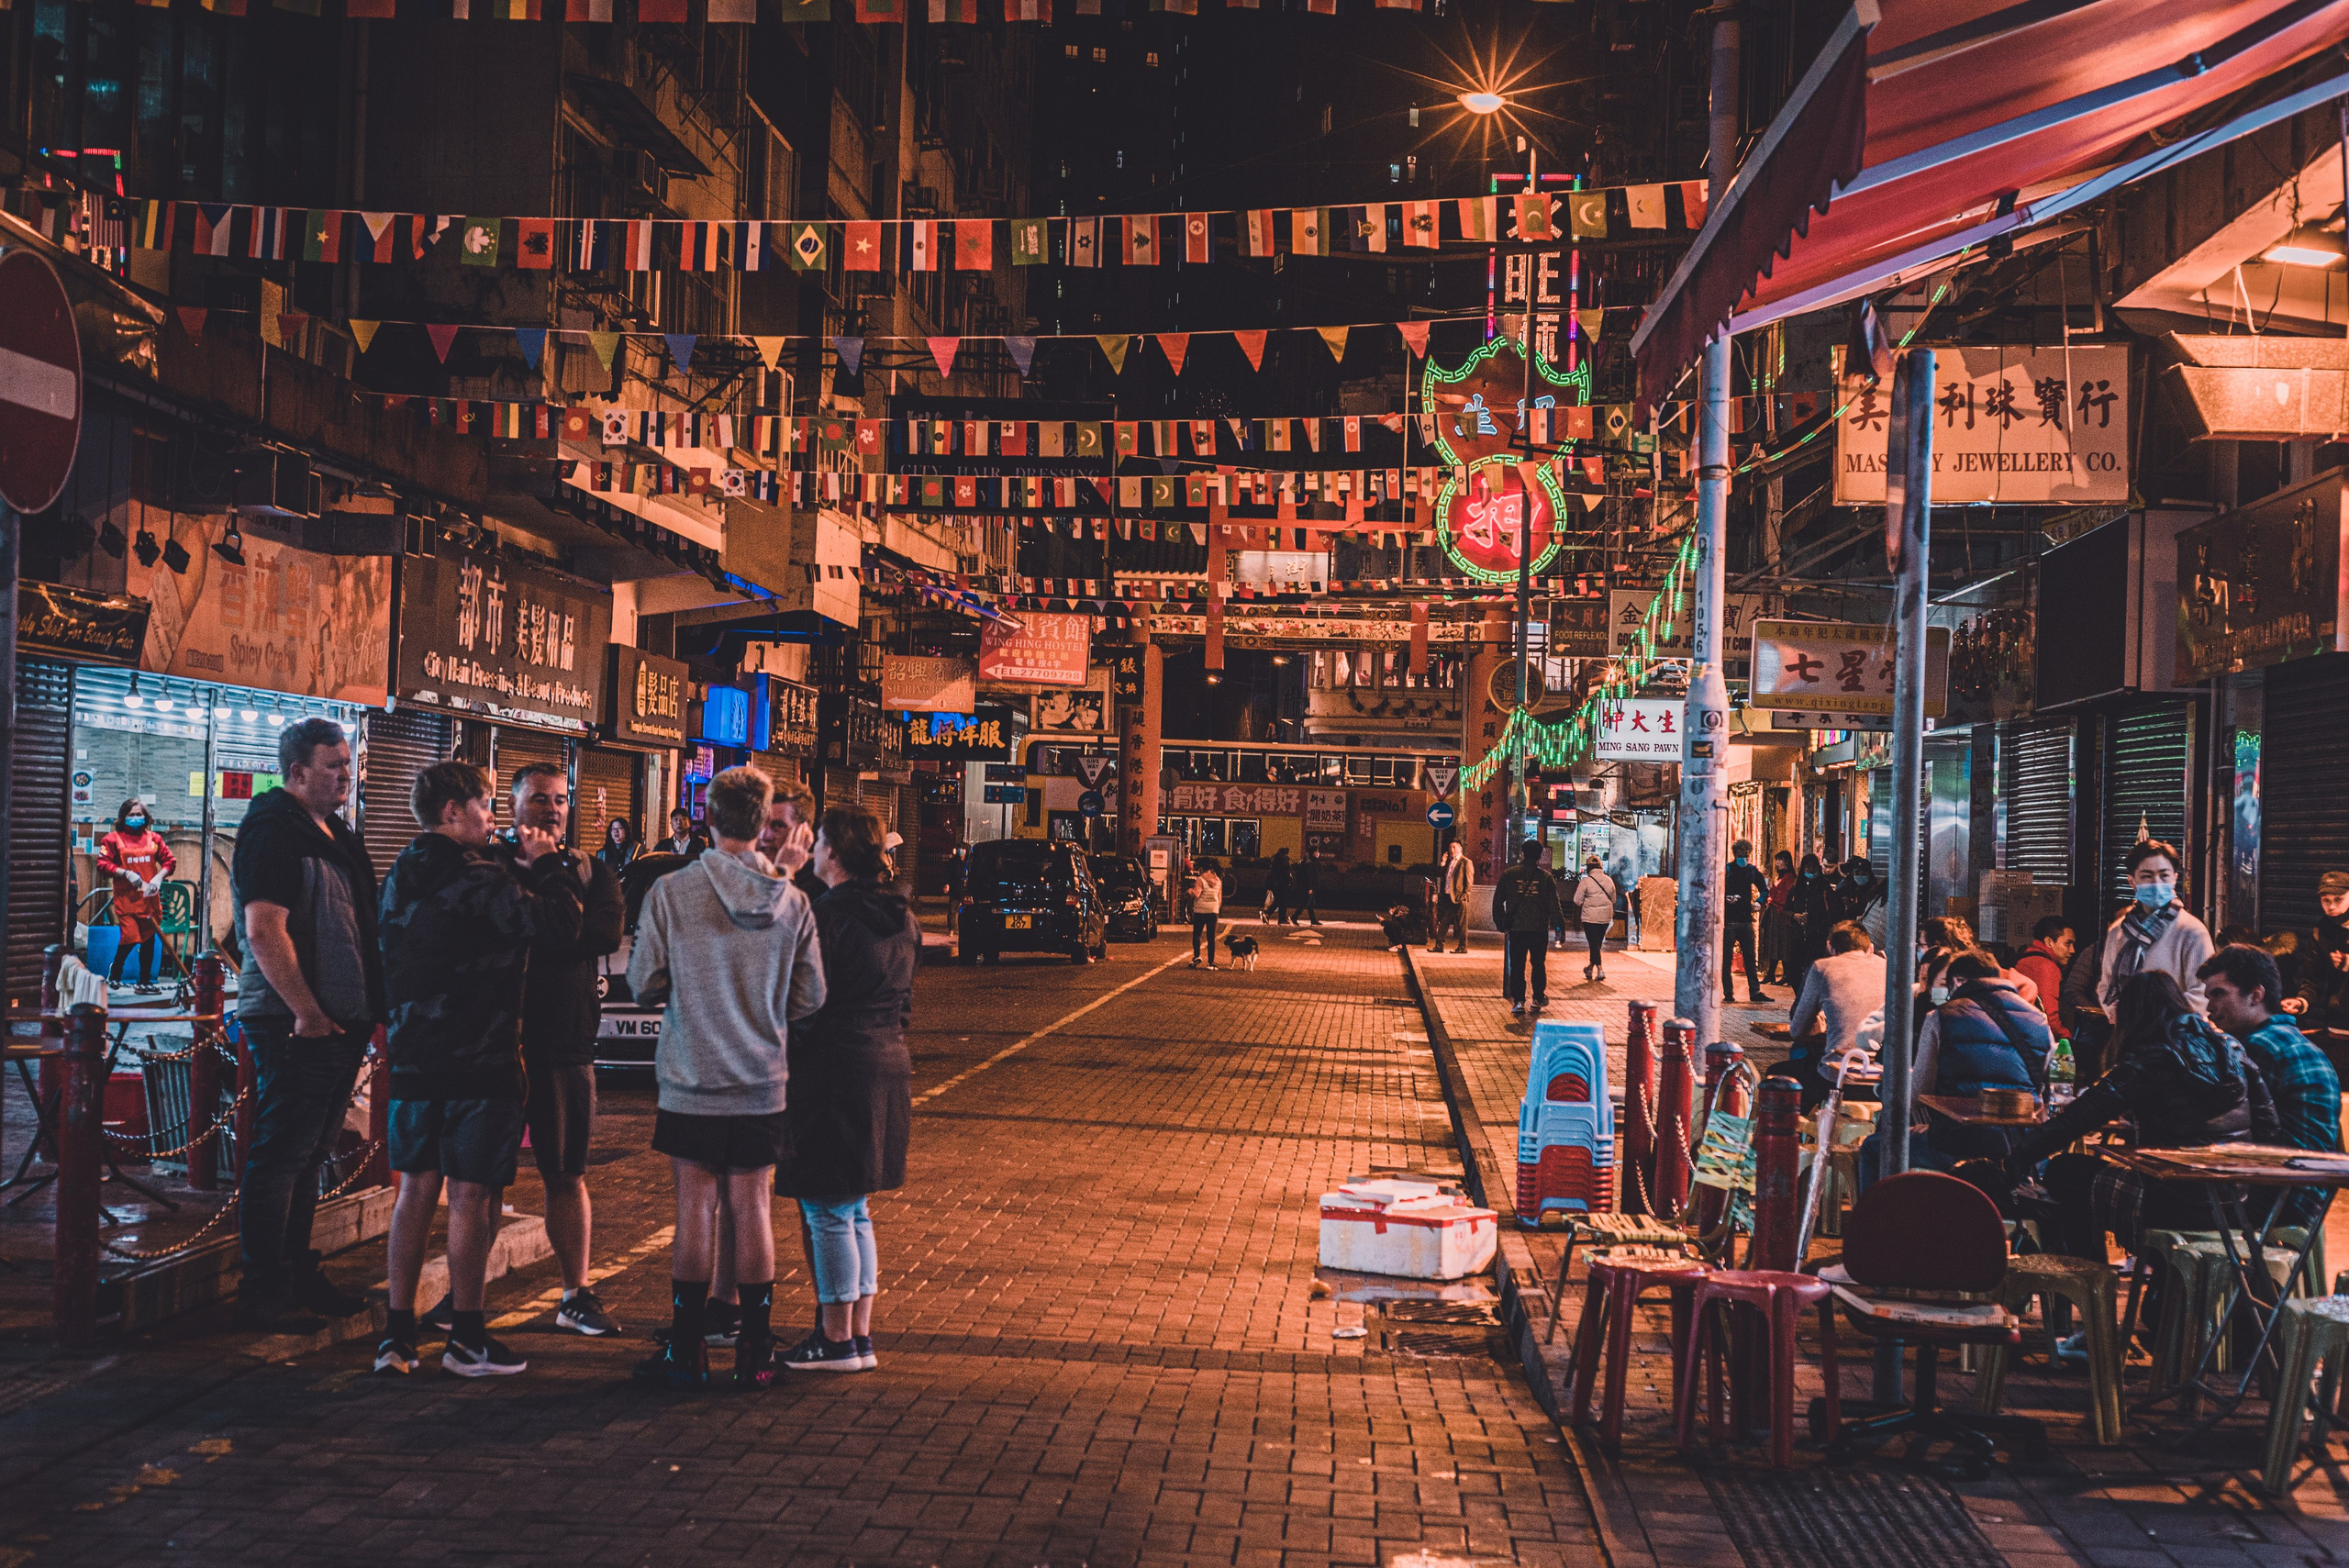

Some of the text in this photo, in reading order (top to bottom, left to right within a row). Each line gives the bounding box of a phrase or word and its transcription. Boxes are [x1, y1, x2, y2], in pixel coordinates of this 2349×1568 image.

[1848, 377, 2119, 432] 美利珠寶行
[1845, 450, 2122, 473] MASY JEWELLERY CO.
[457, 555, 575, 672] 都市 美髮用品
[38, 615, 65, 641] Shop
[83, 621, 114, 651] Beauty
[114, 628, 135, 650] Hair
[985, 637, 1085, 652] WING HING HOSTEL
[1554, 630, 1573, 639] FOOT
[230, 634, 262, 673] Spicy
[424, 650, 448, 685] City
[447, 655, 471, 684] Hair
[471, 661, 515, 700] Dressing
[524, 673, 556, 707] Beauty
[556, 680, 593, 709] Products
[991, 666, 1080, 681] TEL:27709798
[647, 670, 680, 719] 髮品店
[1598, 741, 1679, 753] MING SANG PAWN
[616, 1020, 636, 1035] VM
